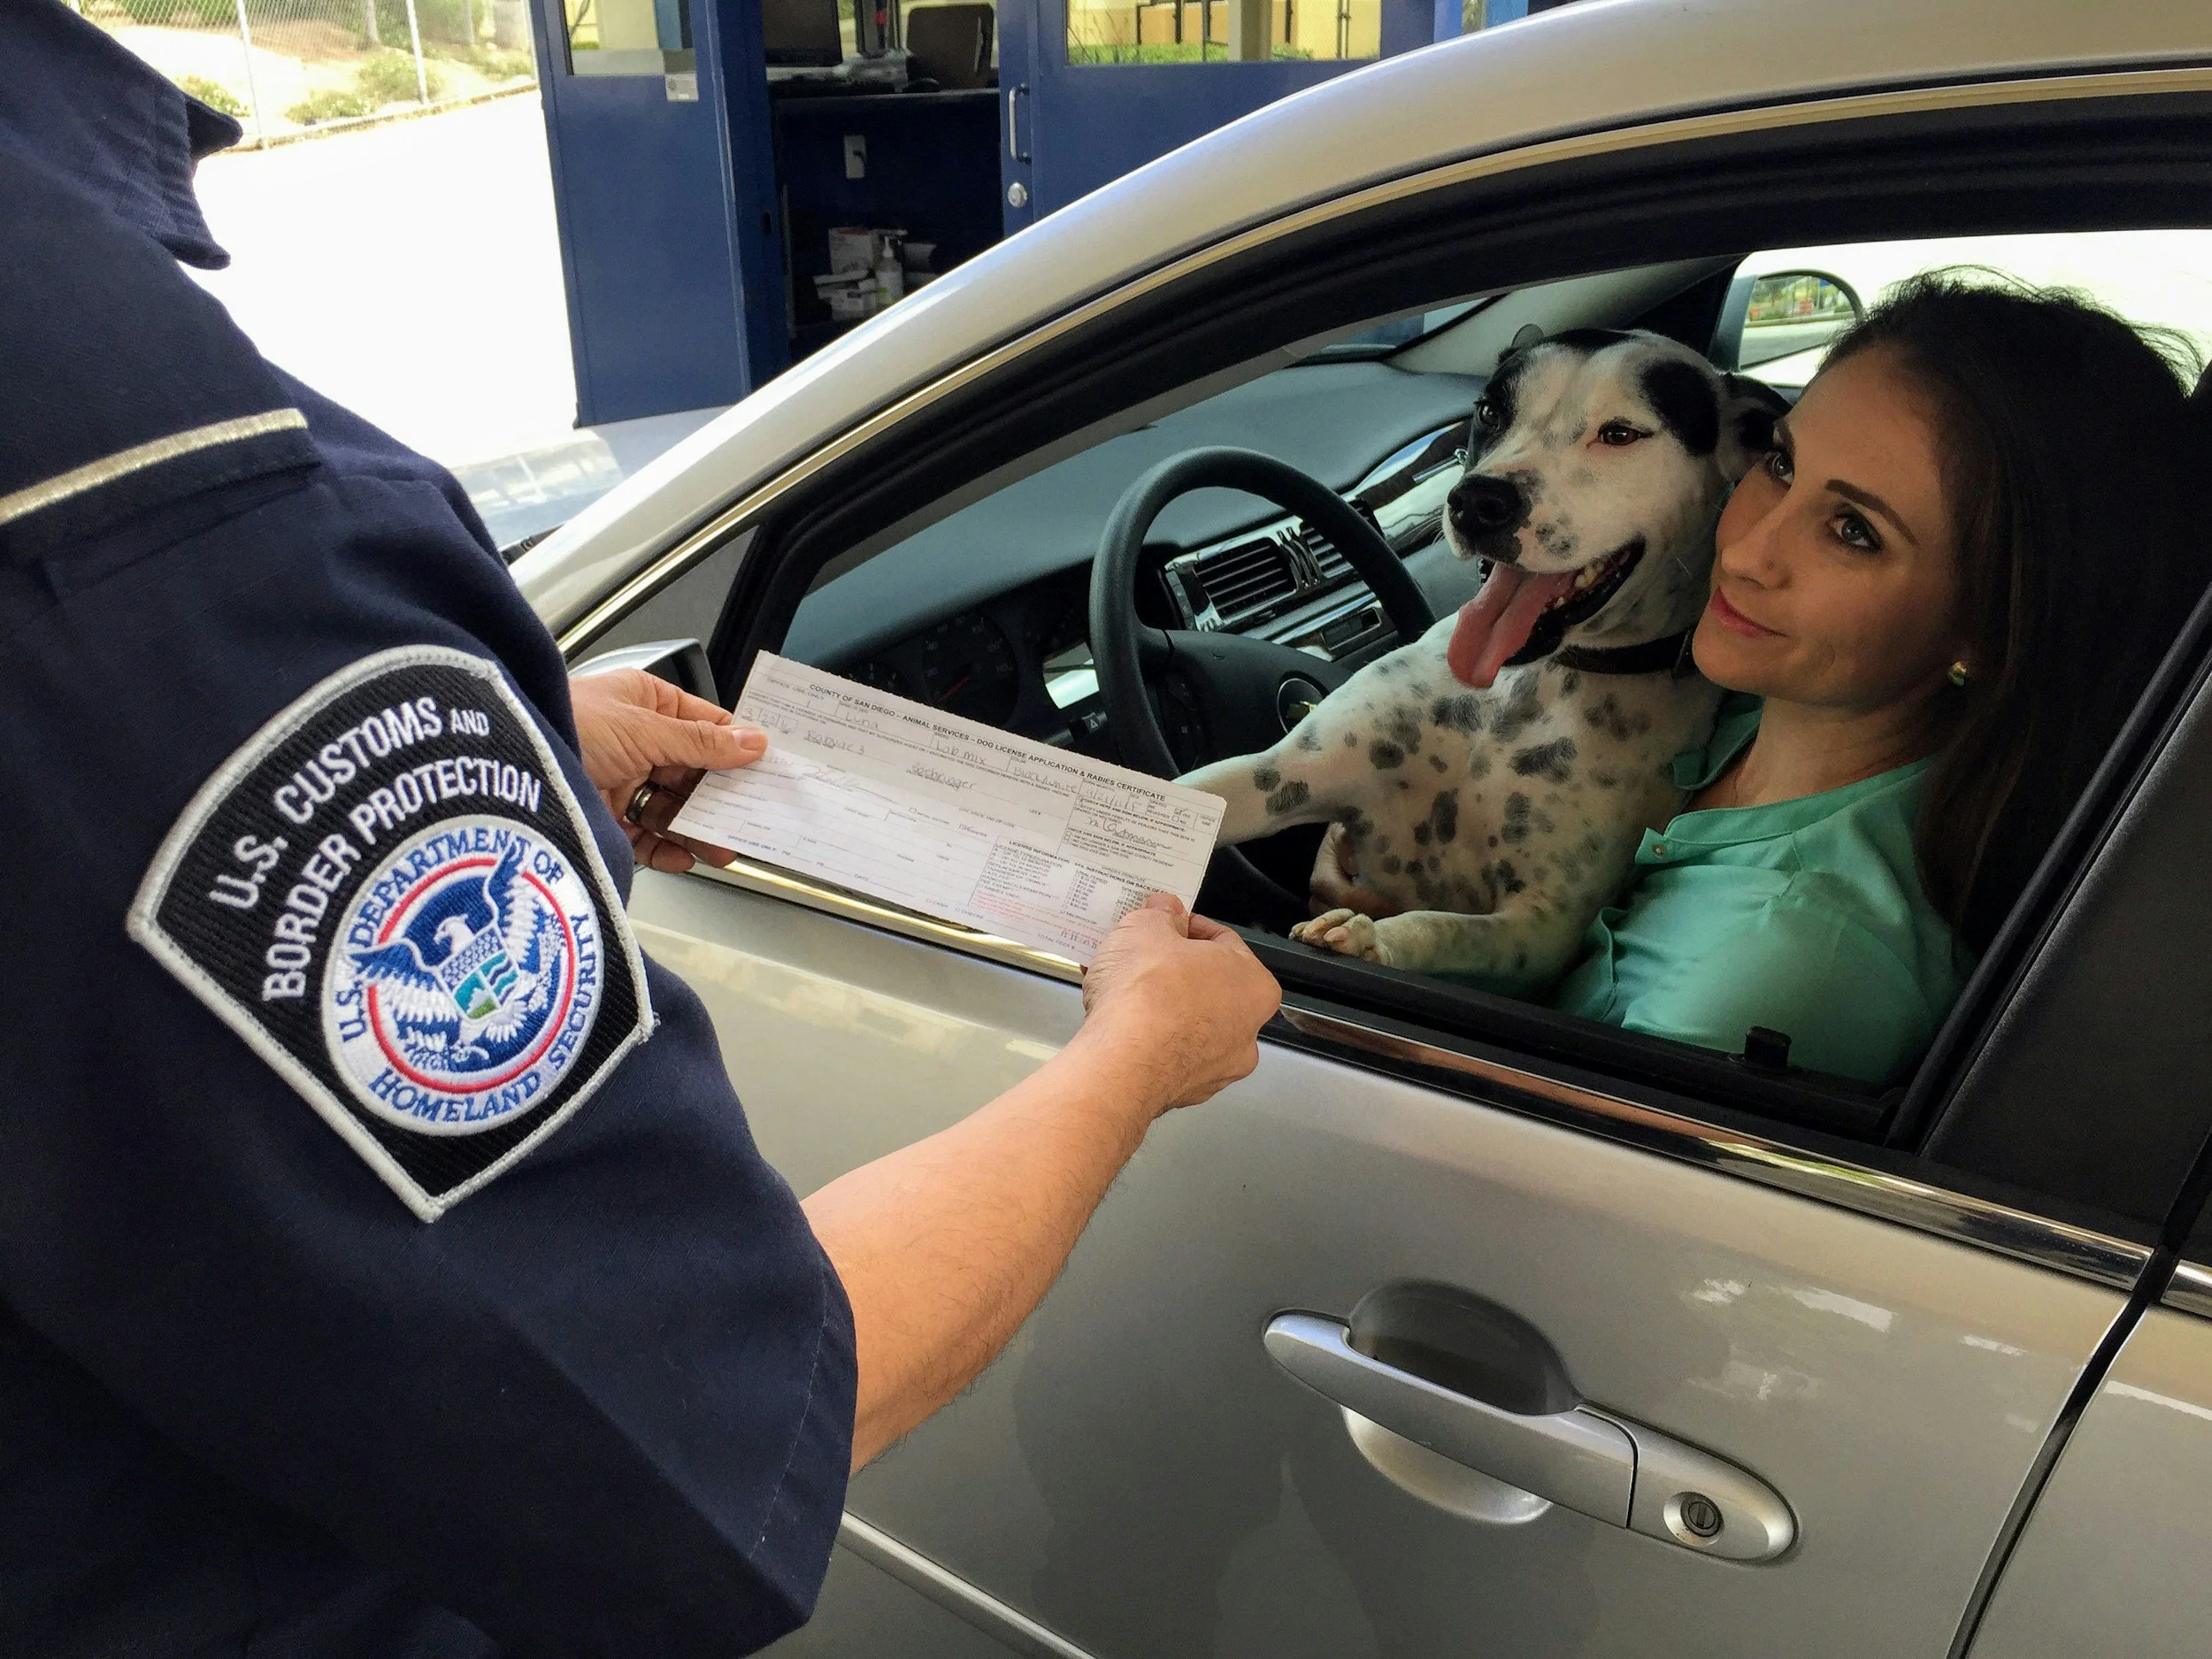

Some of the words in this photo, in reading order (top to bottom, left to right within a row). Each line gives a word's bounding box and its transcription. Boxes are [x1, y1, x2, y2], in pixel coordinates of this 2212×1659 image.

[809, 684, 841, 698] COUNTY
[853, 699, 870, 708] SAN
[871, 704, 895, 717] DIEGO
[902, 715, 932, 728] ANIMAL
[932, 724, 969, 741] SERVICES
[976, 738, 994, 748] DOG
[995, 743, 1027, 758] LICENSE
[1027, 754, 1078, 774] APPLICATION
[1087, 772, 1115, 786] RABIES
[1116, 780, 1165, 802] CERTIFICATE
[209, 835, 288, 910] U.S.
[274, 697, 442, 825] CUSTOMS
[449, 707, 490, 738] AND
[262, 833, 362, 1002] BORDER
[348, 757, 541, 845] PROTECTION
[349, 828, 531, 948] DEPARTMENT
[534, 850, 565, 883] OF
[335, 979, 367, 1042] U.S.
[368, 1070, 541, 1124] HOMELAND
[548, 913, 596, 1071] SECURITY
